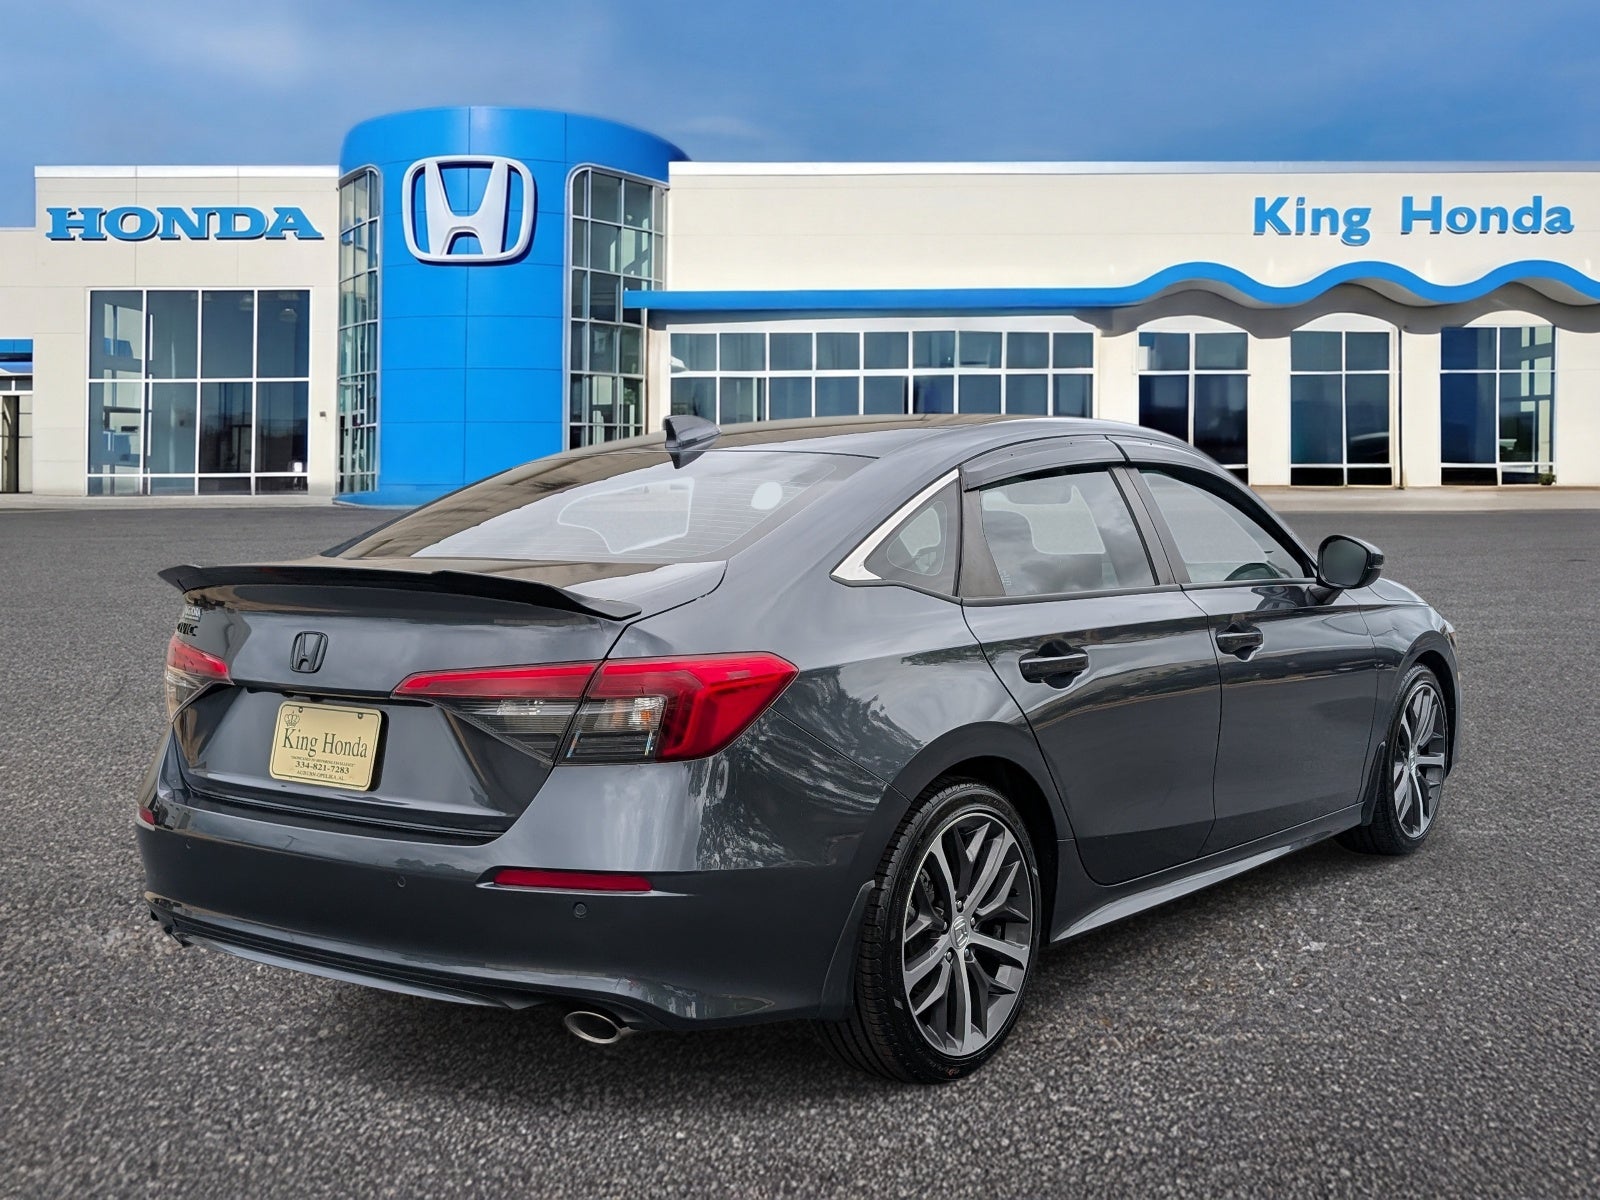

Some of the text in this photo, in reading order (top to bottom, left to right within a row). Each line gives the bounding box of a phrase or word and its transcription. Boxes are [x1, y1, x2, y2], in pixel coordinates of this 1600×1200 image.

[46, 206, 324, 241] HONDA
[1253, 195, 1575, 246] King Honda
[282, 727, 367, 758] King Honda
[295, 760, 350, 775] 334-821-7283
